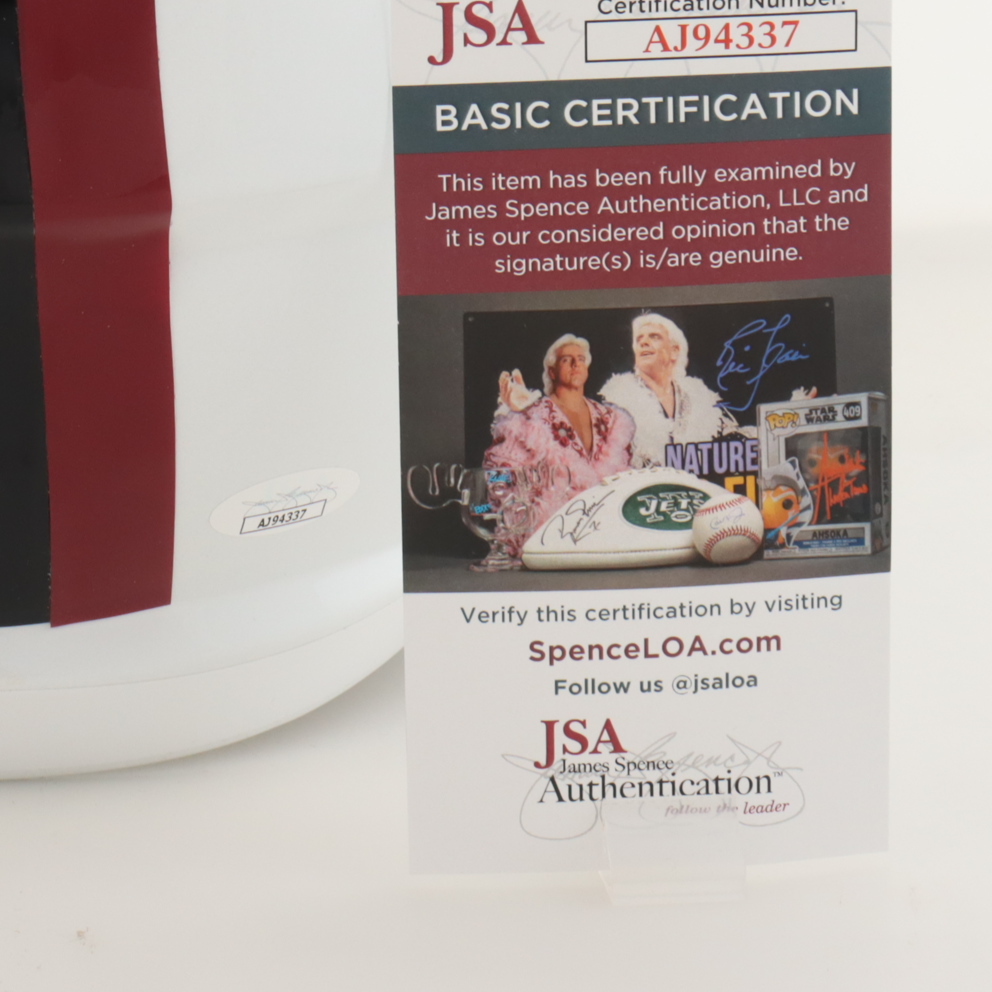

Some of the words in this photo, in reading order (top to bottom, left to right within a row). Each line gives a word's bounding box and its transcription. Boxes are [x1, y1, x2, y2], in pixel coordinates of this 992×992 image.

[427, 0, 545, 66] JSA
[643, 20, 801, 54] AJ94337
[435, 101, 551, 132] BASIC
[564, 88, 860, 128] CERTIFICATION
[438, 173, 484, 193] This
[490, 171, 541, 191] item
[548, 168, 588, 189] has
[595, 166, 651, 187] been
[658, 163, 707, 188] fully
[713, 159, 822, 184] examined
[829, 157, 856, 180] by
[425, 201, 498, 222] James
[504, 198, 590, 222] Spence
[597, 191, 771, 216] Authentication,
[778, 188, 821, 208] LLC
[828, 184, 869, 204] and
[445, 227, 460, 248] it
[467, 227, 485, 247] is
[492, 231, 529, 246] our
[537, 221, 665, 245] considered
[671, 219, 756, 245] opinion
[762, 216, 808, 237] that
[814, 215, 850, 235] the
[494, 251, 632, 277] signature(s)
[639, 247, 702, 272] is/are
[708, 244, 804, 269] genuine.
[765, 411, 800, 431] POP!
[843, 405, 861, 418] 409
[666, 440, 759, 476] NATURE
[257, 508, 307, 529] AJ94337
[460, 605, 529, 627] Verify
[536, 604, 577, 623] this
[585, 600, 722, 622] certification
[729, 597, 756, 620] by
[764, 592, 843, 614] visiting
[528, 632, 782, 666] SpenceLOA.com
[554, 677, 631, 696] Follow
[639, 678, 663, 693] us
[671, 672, 759, 696] @jsaloa
[533, 718, 628, 770] JSA
[559, 758, 610, 774] James
[614, 756, 675, 775] Spence
[664, 804, 712, 818] follow
[743, 801, 790, 815] leader
